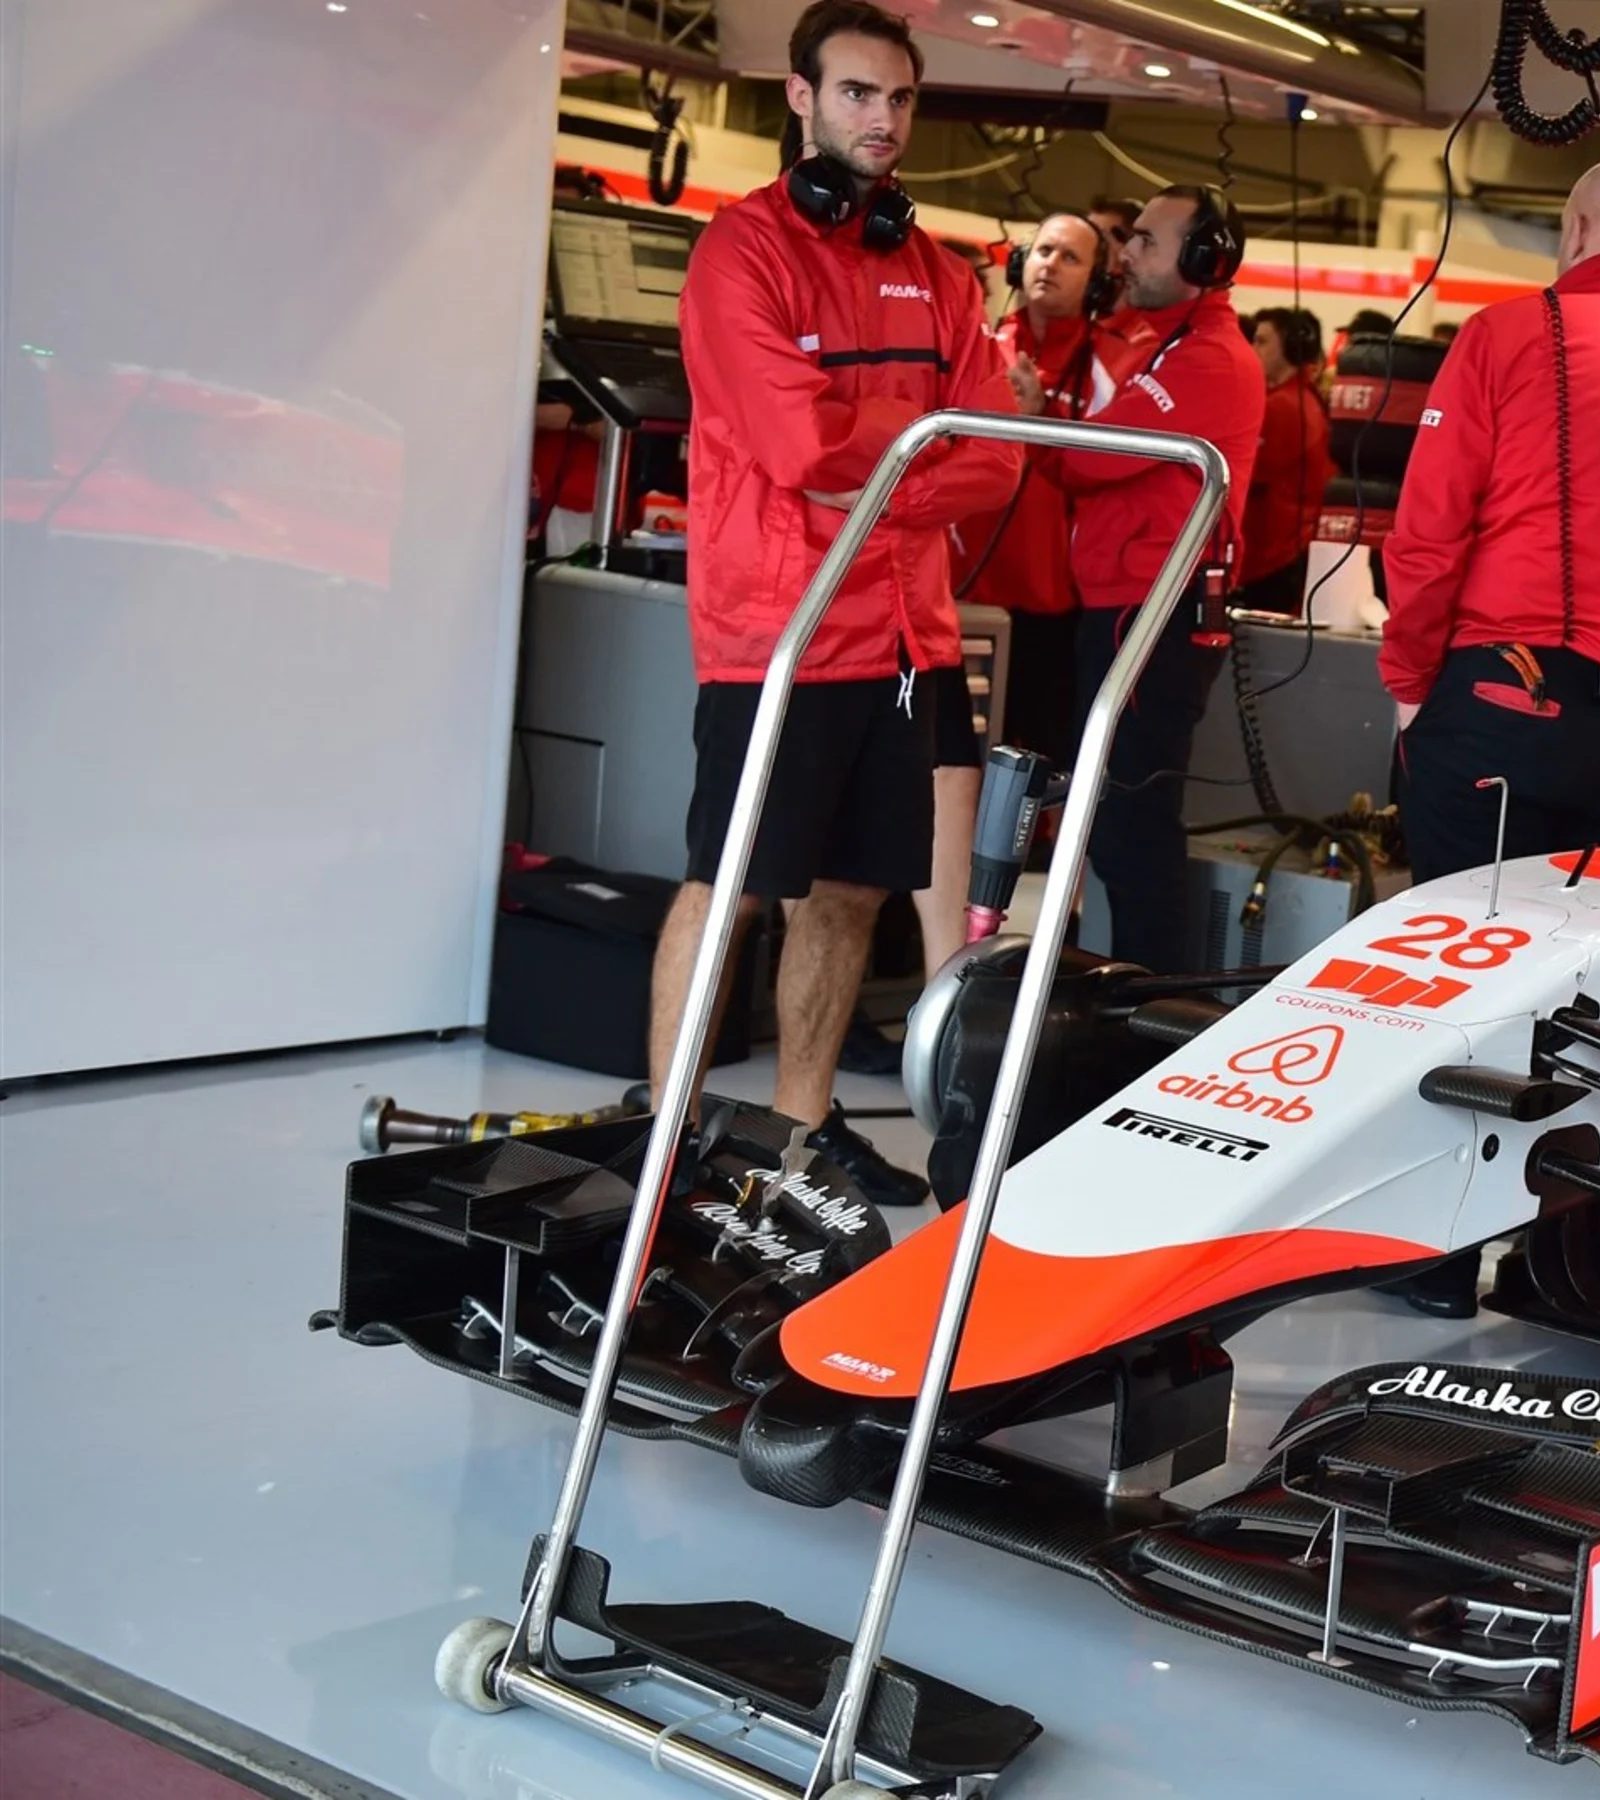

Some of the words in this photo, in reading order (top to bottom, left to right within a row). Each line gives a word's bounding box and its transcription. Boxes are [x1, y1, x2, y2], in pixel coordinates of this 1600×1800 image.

[1366, 914, 1532, 970] 28
[1275, 993, 1426, 1032] COUPONS.com
[1157, 1074, 1313, 1123] airbnb
[1102, 1107, 1270, 1162] PIRELLI
[816, 1197, 868, 1235] Coffee
[1367, 1366, 1555, 1419] Alaska
